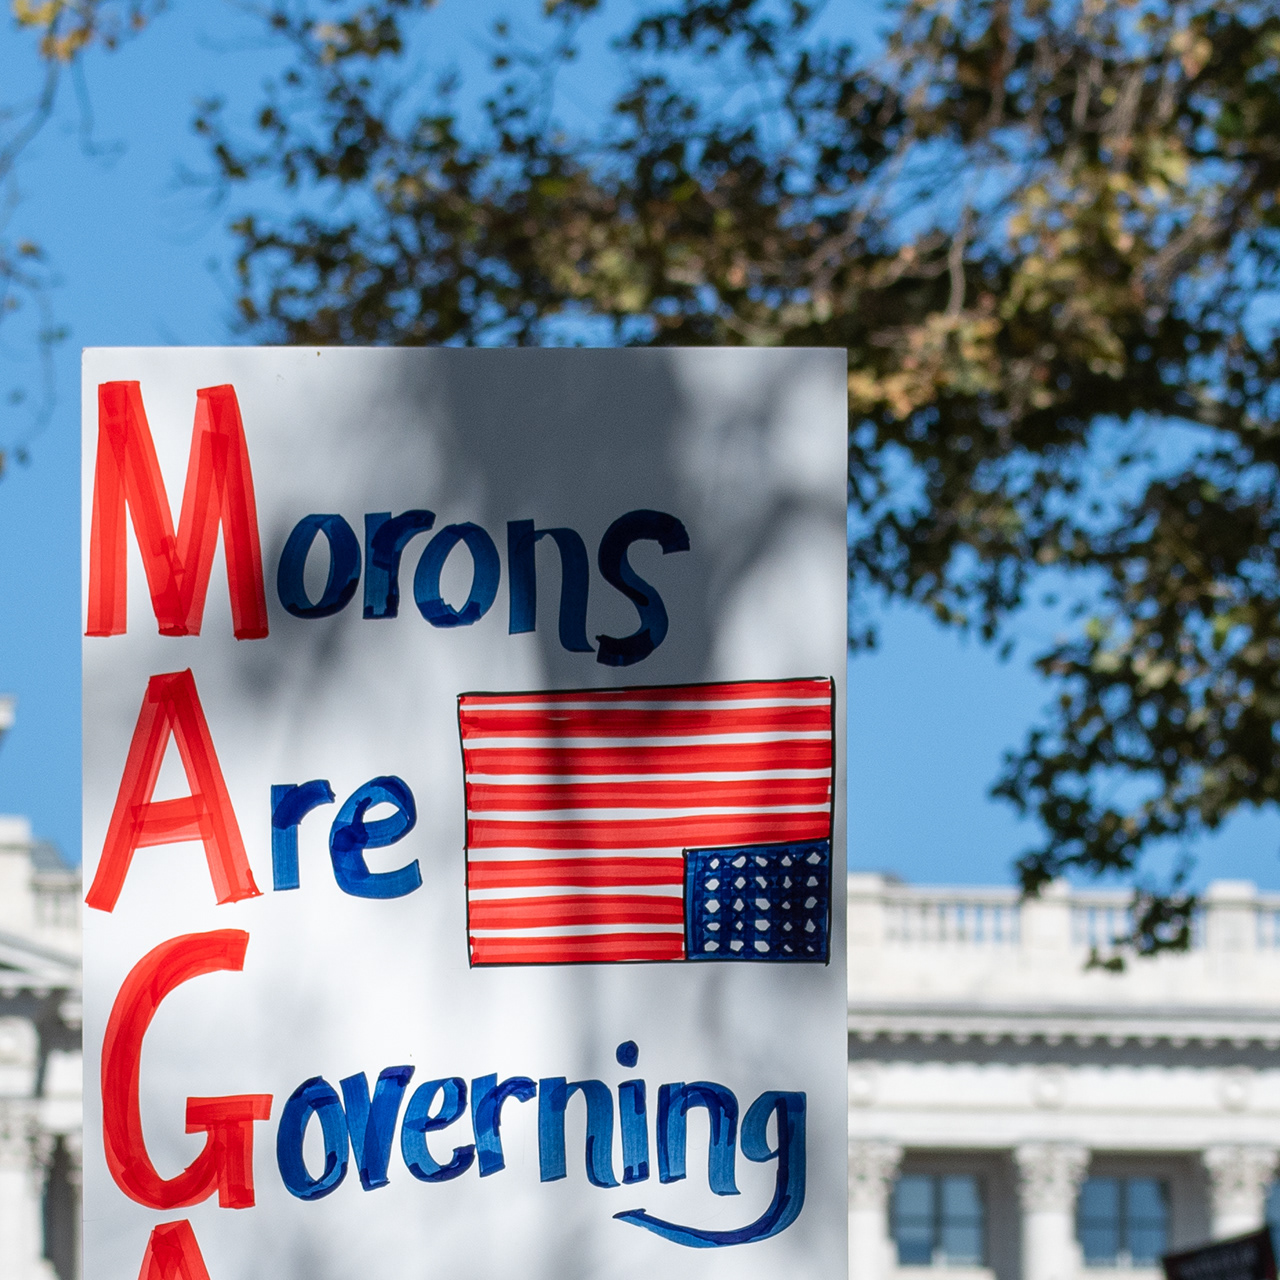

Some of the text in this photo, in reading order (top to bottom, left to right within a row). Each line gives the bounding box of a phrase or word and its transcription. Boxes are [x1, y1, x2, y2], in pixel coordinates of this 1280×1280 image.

[84, 379, 691, 668] Morons
[84, 668, 423, 913] Are
[100, 928, 807, 1249] Governing
